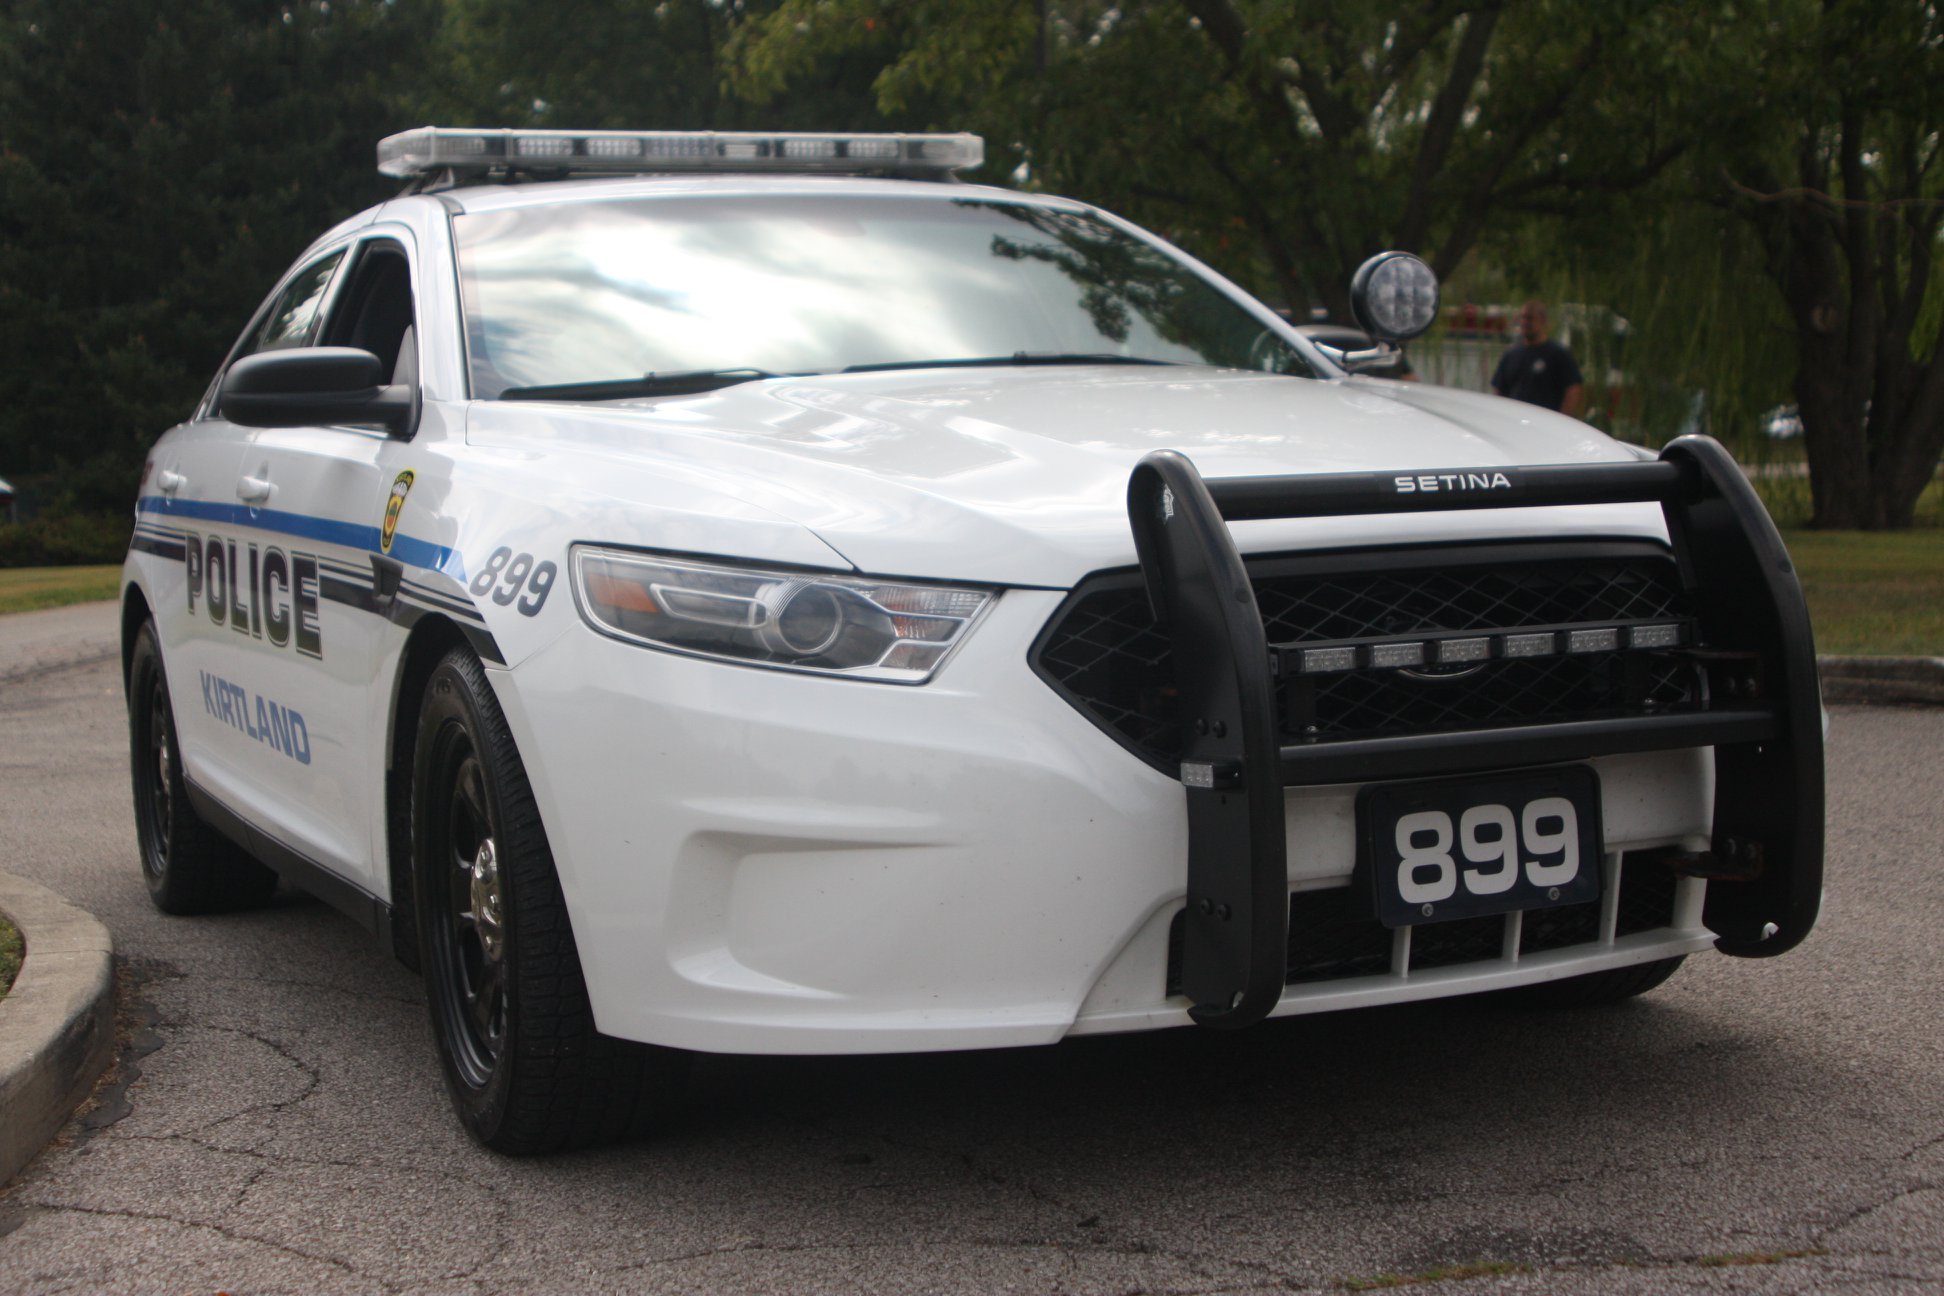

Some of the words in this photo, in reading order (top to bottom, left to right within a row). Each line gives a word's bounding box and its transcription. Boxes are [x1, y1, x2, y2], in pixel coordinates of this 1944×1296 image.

[1395, 473, 1512, 493] SETINA
[186, 530, 323, 661] POLICE
[469, 546, 558, 618] 899
[200, 669, 311, 766] KIRTLAND
[1395, 797, 1580, 904] 899
